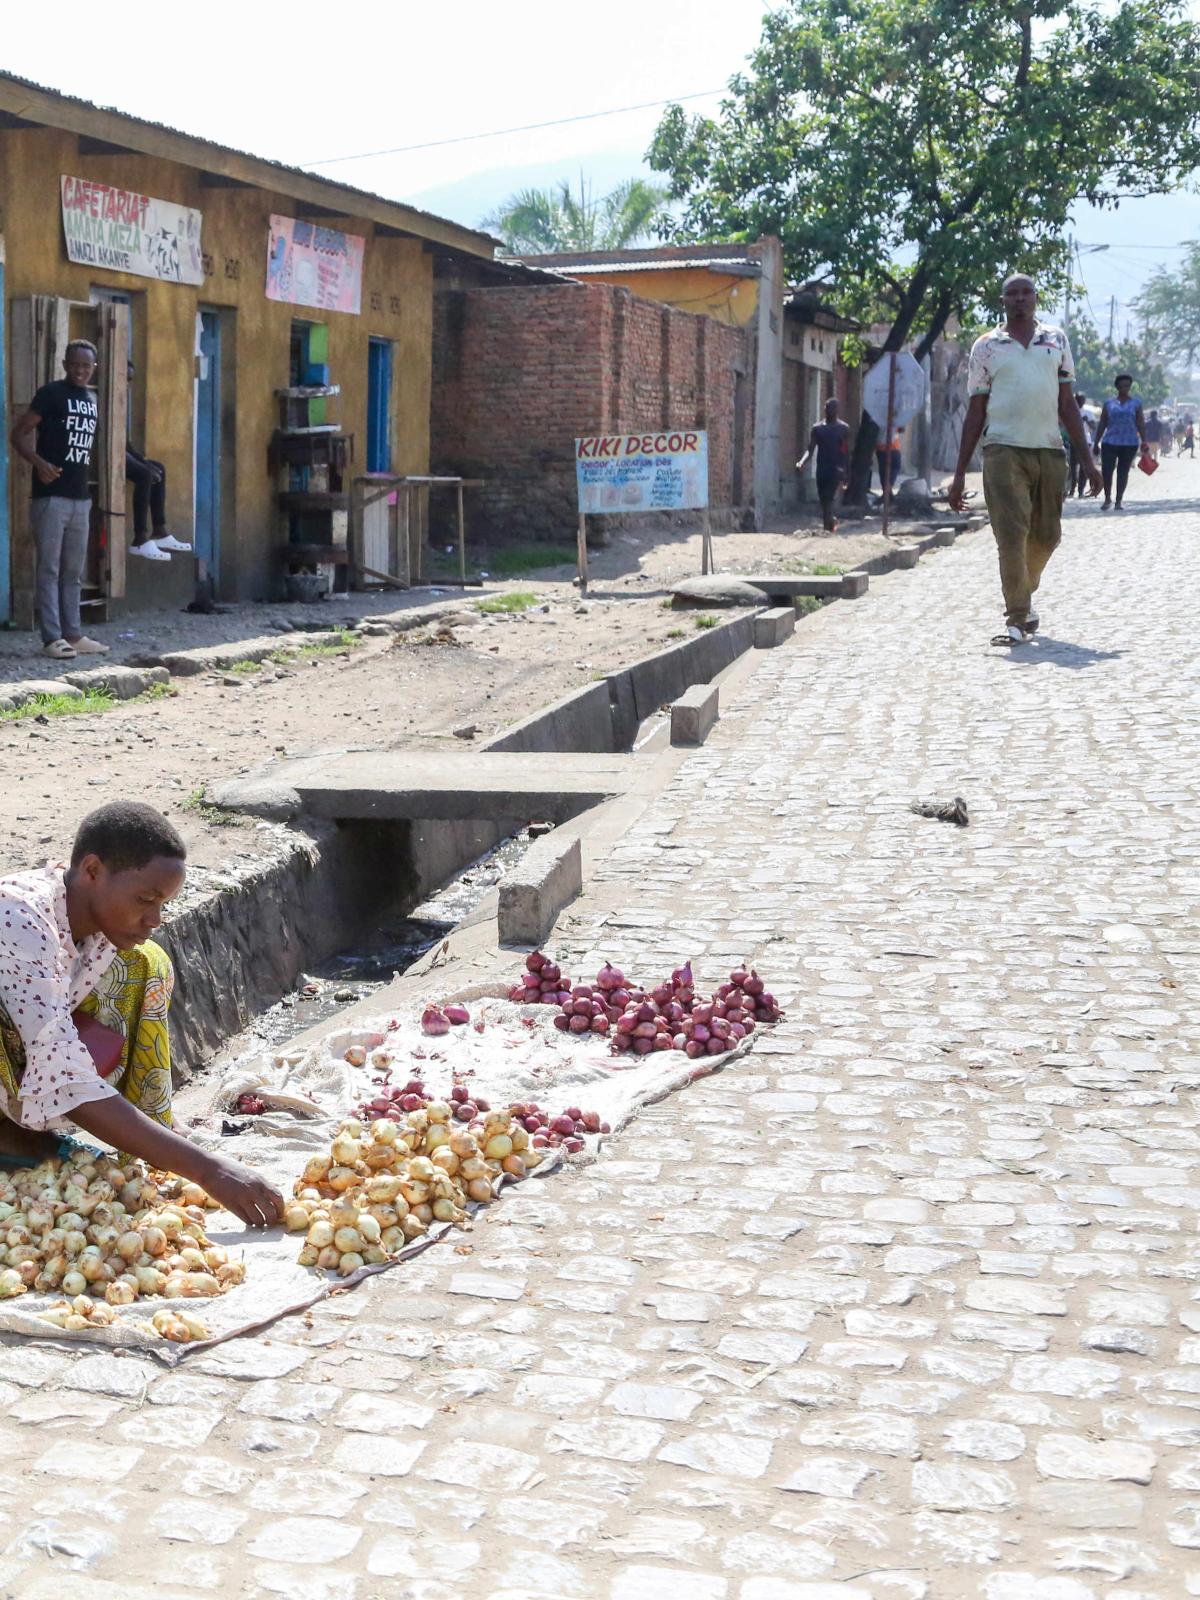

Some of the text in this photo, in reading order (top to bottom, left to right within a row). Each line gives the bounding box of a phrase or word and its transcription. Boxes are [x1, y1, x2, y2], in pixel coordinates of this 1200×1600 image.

[65, 209, 141, 255] AMATA MEZA
[69, 238, 130, 270] AMAZI AKANYE
[66, 416, 97, 434] FLAS
[578, 433, 698, 458] KIKI DECOR
